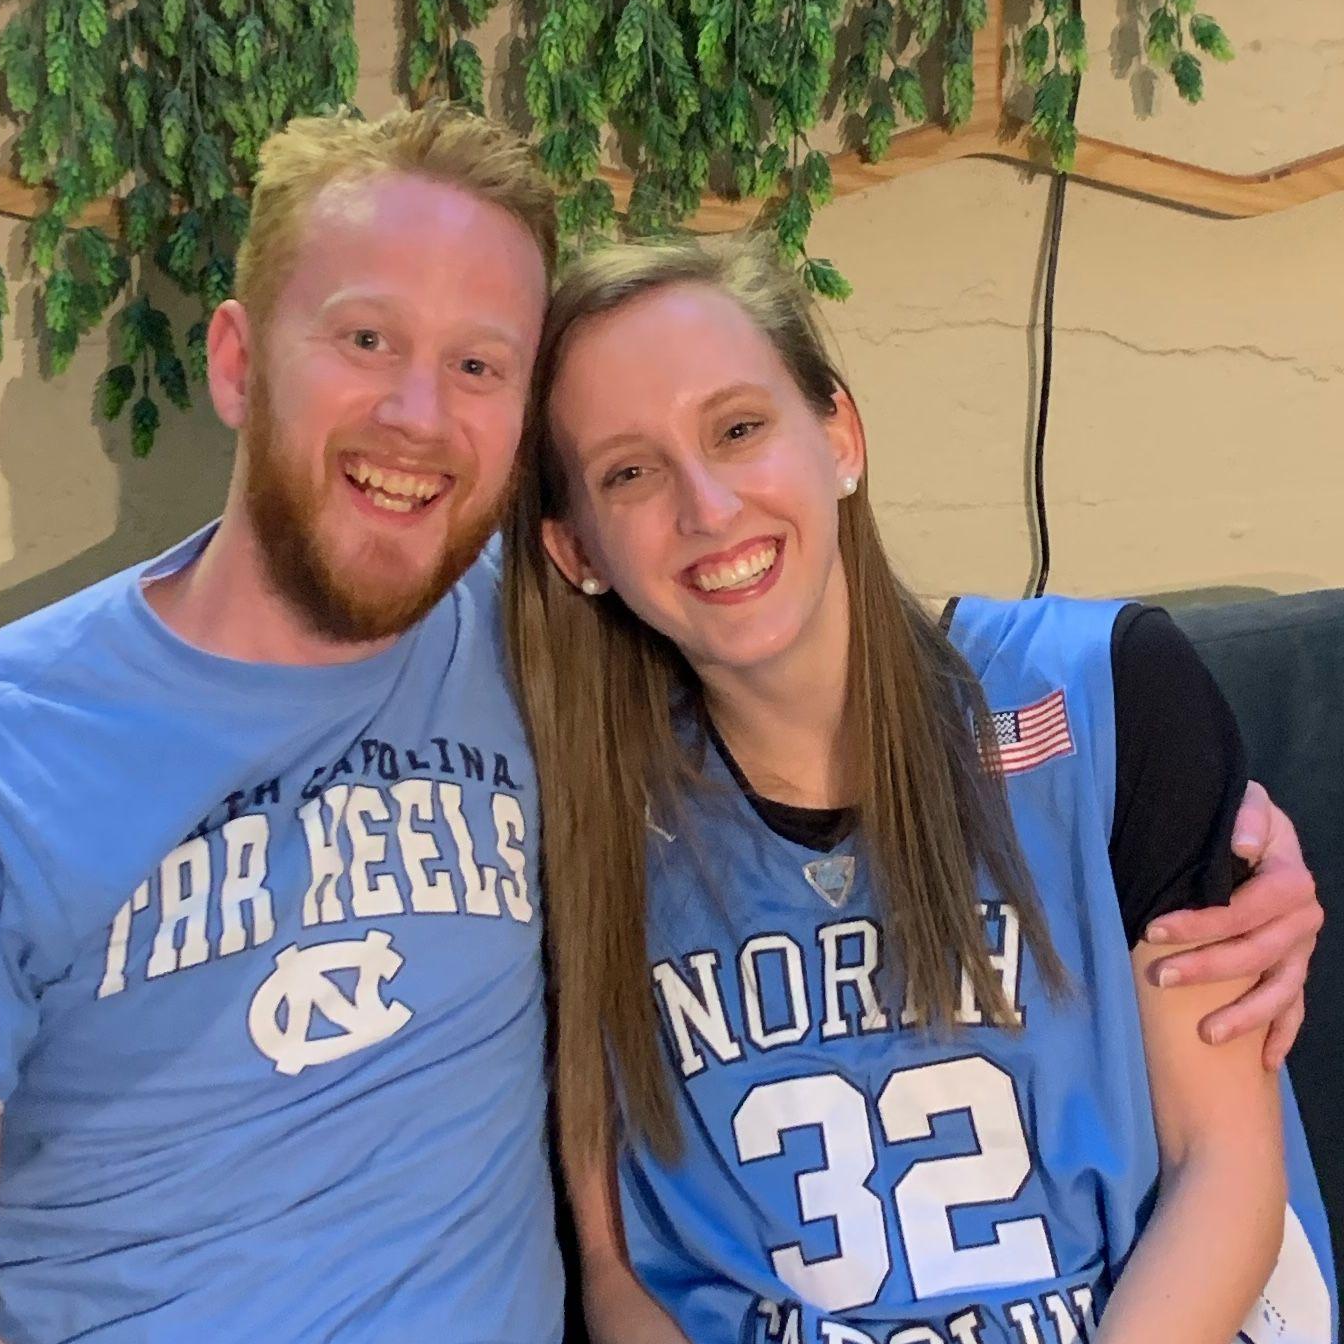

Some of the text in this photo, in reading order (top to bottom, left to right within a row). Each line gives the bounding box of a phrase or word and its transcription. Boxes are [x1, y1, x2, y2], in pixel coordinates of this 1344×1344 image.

[96, 813, 276, 1000] TAR
[297, 777, 534, 927] HEELS
[652, 898, 1027, 1079] NORH
[731, 1054, 1060, 1316] 32
